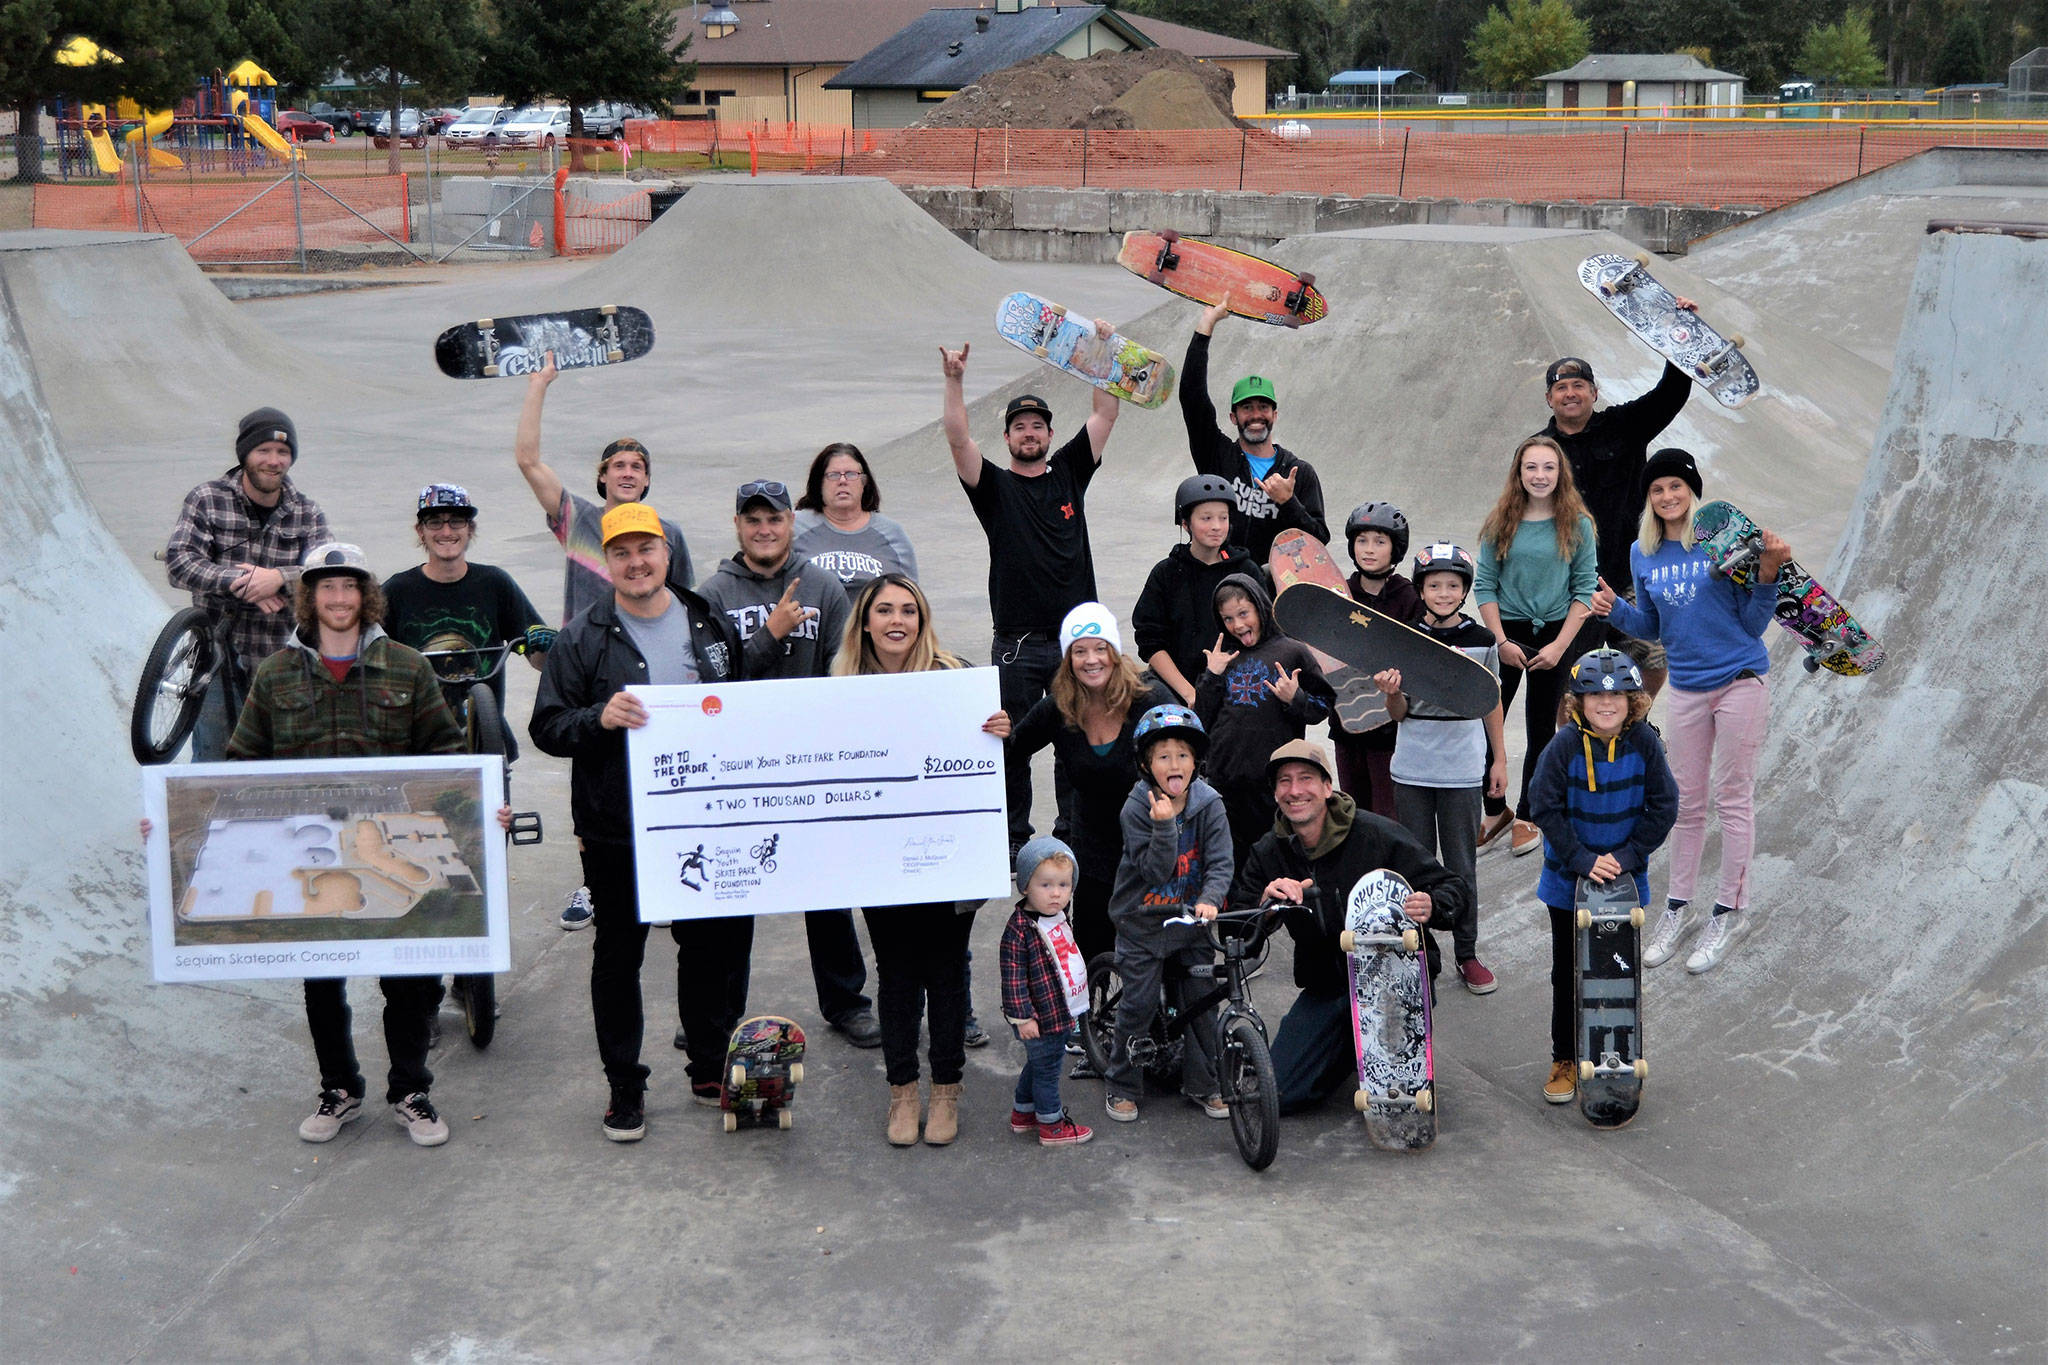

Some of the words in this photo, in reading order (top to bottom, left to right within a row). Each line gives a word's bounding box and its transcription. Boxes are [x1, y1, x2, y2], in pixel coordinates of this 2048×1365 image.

[810, 555, 837, 570] AIR
[838, 555, 884, 578] FORCE
[1652, 560, 1711, 585] HURLEY
[654, 753, 674, 766] PAY
[677, 750, 690, 763] TO
[757, 755, 781, 769] YOUTH
[838, 749, 889, 760] FOUNDATION
[923, 755, 995, 774] $2000.00
[653, 766, 675, 778] THE
[677, 762, 709, 775] ORDER
[670, 776, 687, 787] OF
[716, 799, 747, 811] TWO
[752, 794, 816, 808] THOUSAND
[825, 790, 872, 804] DOLLARS
[175, 955, 226, 969] Sequim
[229, 951, 297, 965] Skatepark
[300, 949, 361, 964] Concept
